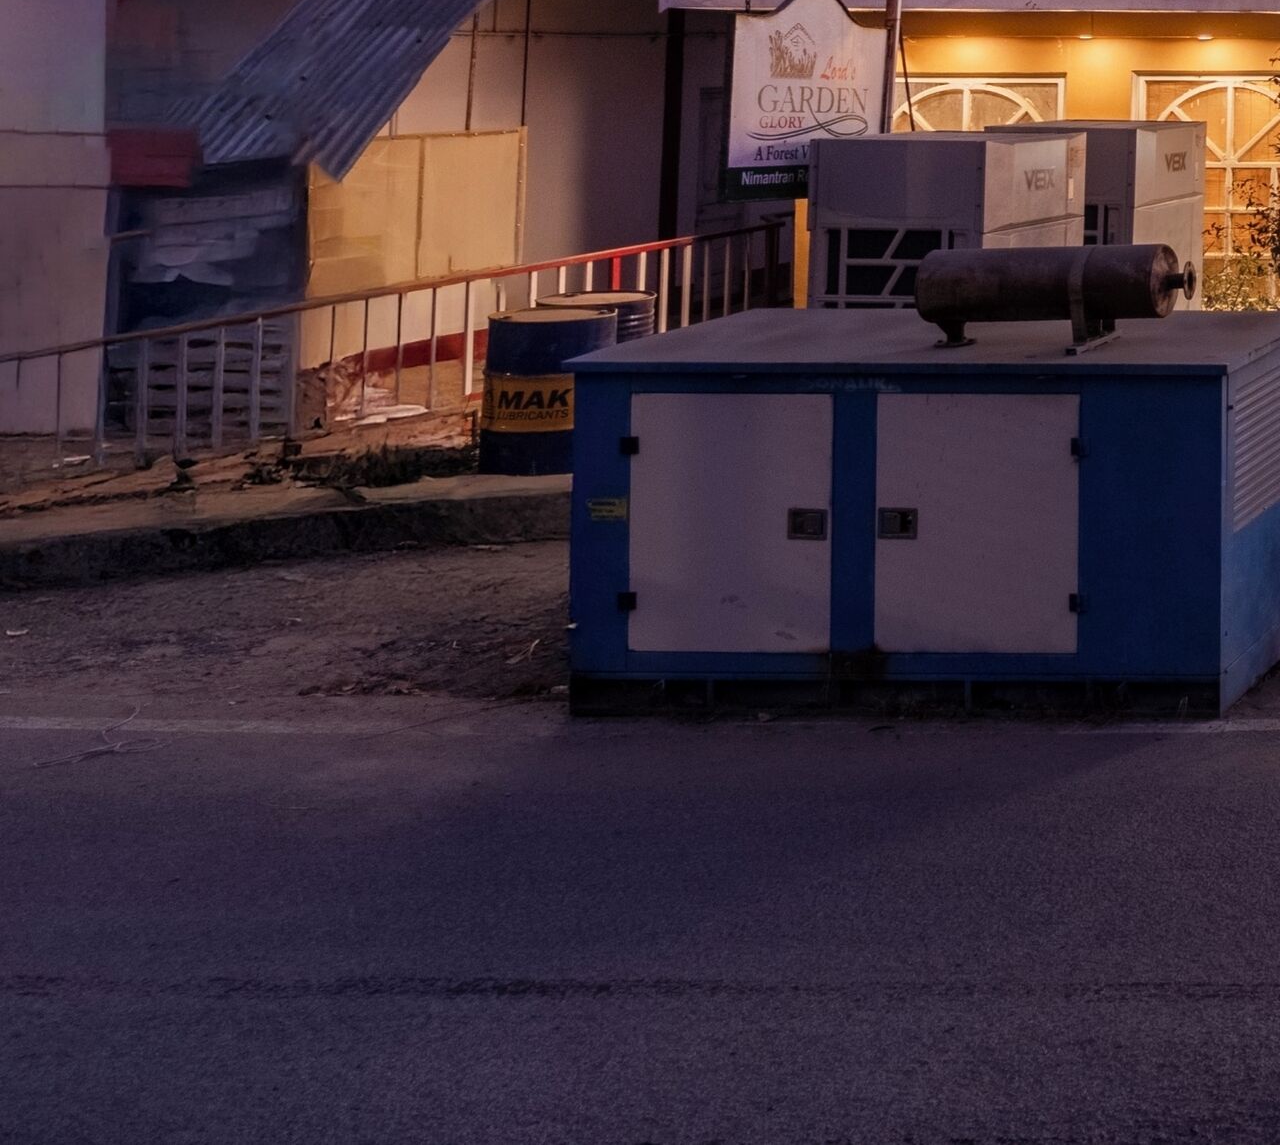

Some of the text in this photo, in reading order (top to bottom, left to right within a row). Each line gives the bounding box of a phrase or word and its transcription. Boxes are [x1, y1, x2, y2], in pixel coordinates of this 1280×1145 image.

[820, 55, 857, 81] Lord's
[757, 84, 869, 115] GARDEN
[759, 115, 806, 129] GLORY
[754, 145, 764, 161] A
[765, 144, 799, 161] Forest
[741, 170, 795, 186] Nimantran
[498, 389, 573, 410] MAK
[496, 409, 569, 421] LUBRICANTS
